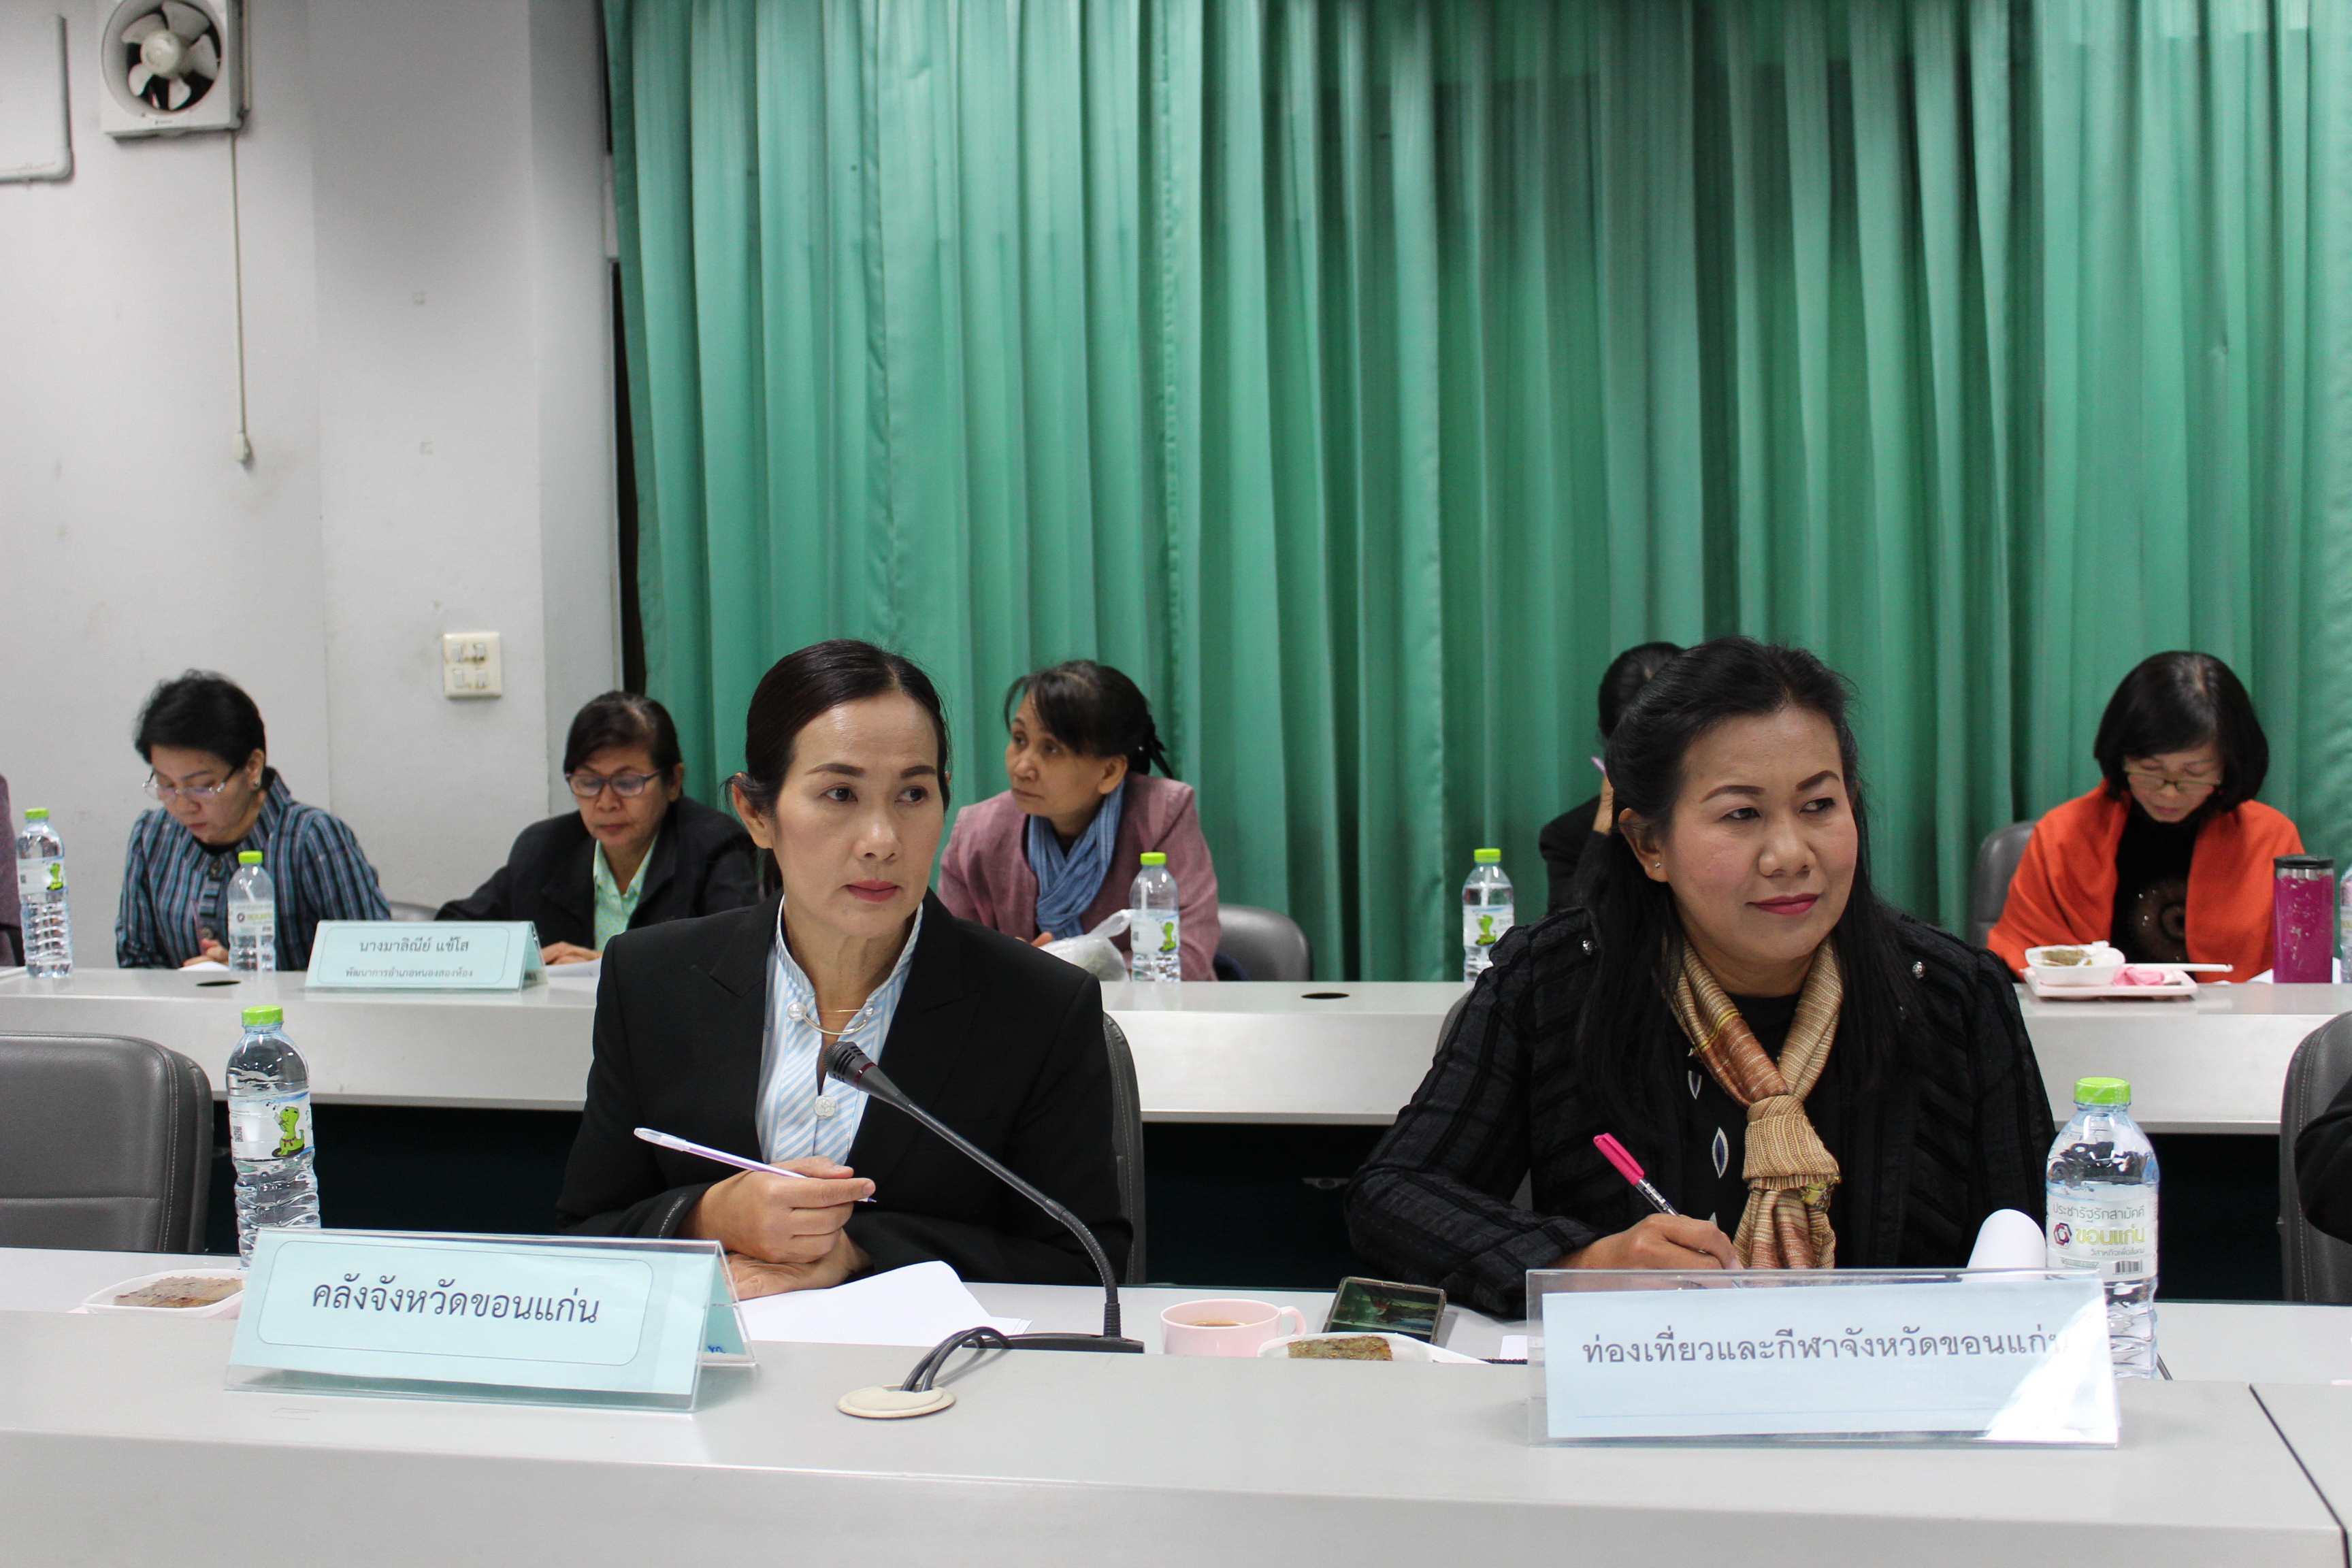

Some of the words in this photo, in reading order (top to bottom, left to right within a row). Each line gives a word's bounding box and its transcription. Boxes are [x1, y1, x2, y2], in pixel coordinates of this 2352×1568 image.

[2053, 1203, 2144, 1222] ประชารัฐรักสามัคคี
[2076, 1224, 2144, 1245] ขอนแก่น
[312, 1273, 600, 1324] คลังจังหวัดขอนแก่น
